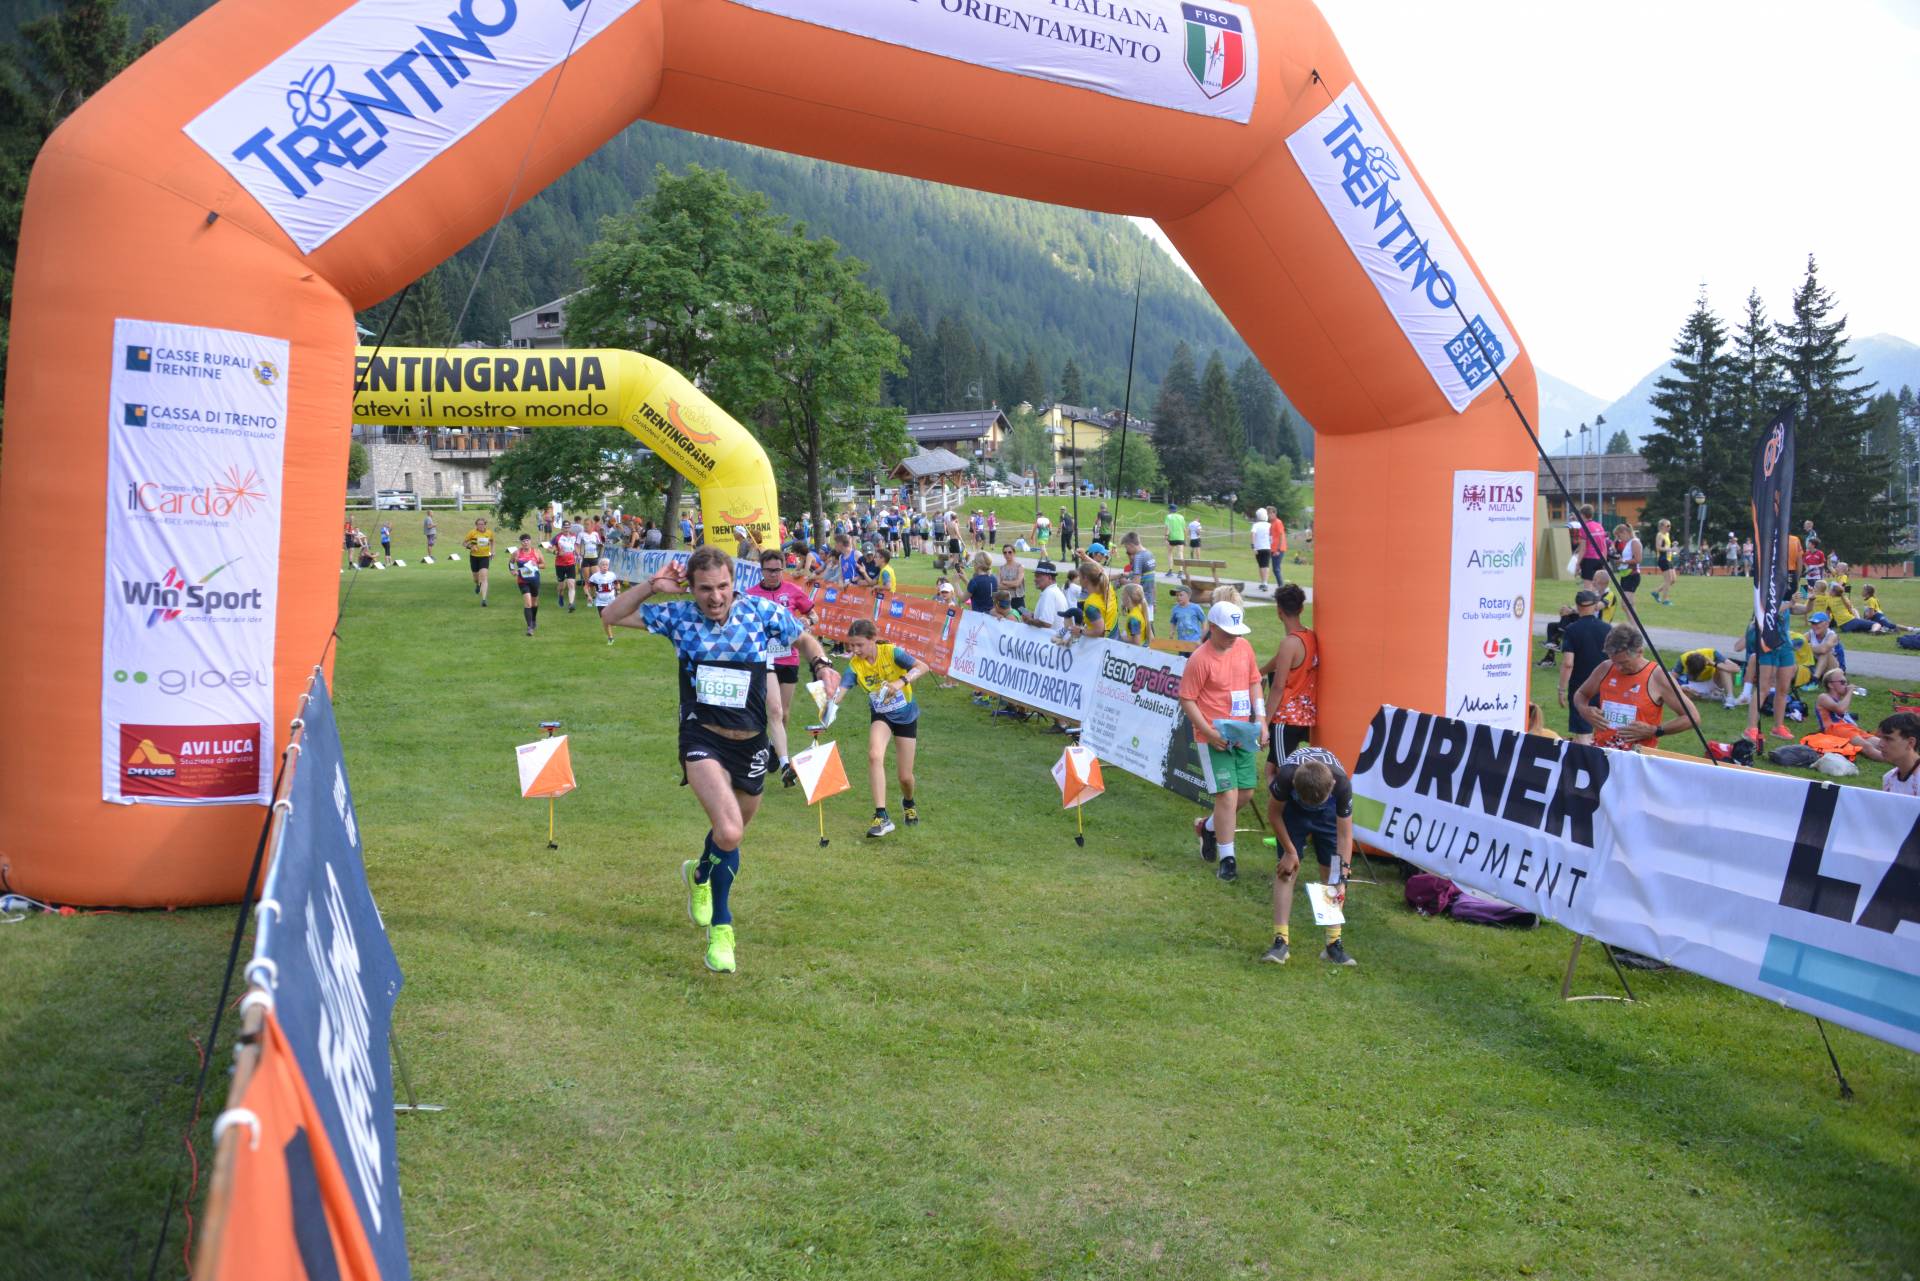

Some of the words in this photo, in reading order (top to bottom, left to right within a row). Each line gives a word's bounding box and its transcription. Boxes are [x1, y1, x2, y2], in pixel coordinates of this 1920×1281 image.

[1050, 0, 1169, 34] ALIANA
[1194, 9, 1228, 26] FISO
[941, 0, 1162, 64] ORIENTAMENTO
[232, 0, 518, 200] TRENTINO
[1322, 103, 1457, 309] TRENTINO
[1472, 321, 1501, 363] ALPE
[155, 362, 222, 380] TRENTINE
[156, 348, 200, 363] CASSE
[204, 352, 251, 369] RURALI
[1450, 340, 1481, 384] BRA
[151, 405, 201, 422] CASSA
[205, 410, 221, 423] DI
[224, 412, 277, 429] TRENTO
[420, 395, 433, 418] il
[443, 401, 516, 418] nostro
[525, 393, 608, 418] mondo
[639, 402, 716, 471] TRENTINGRANA
[1488, 503, 1516, 512] MUTUA
[1489, 485, 1523, 503] ITAS
[122, 581, 179, 607] Win
[186, 586, 262, 614] Sport
[1480, 597, 1512, 610] Rotary
[1462, 612, 1479, 620] Club
[999, 634, 1073, 673] CAMPIGLIO
[700, 680, 734, 697] 1699
[978, 657, 1029, 693] DOLOMITI
[1027, 671, 1043, 697] DI
[1039, 675, 1083, 710] BRENTA
[180, 741, 210, 756] AVI
[213, 739, 254, 755] LUCA
[1385, 807, 1588, 908] EQUIPMENT
